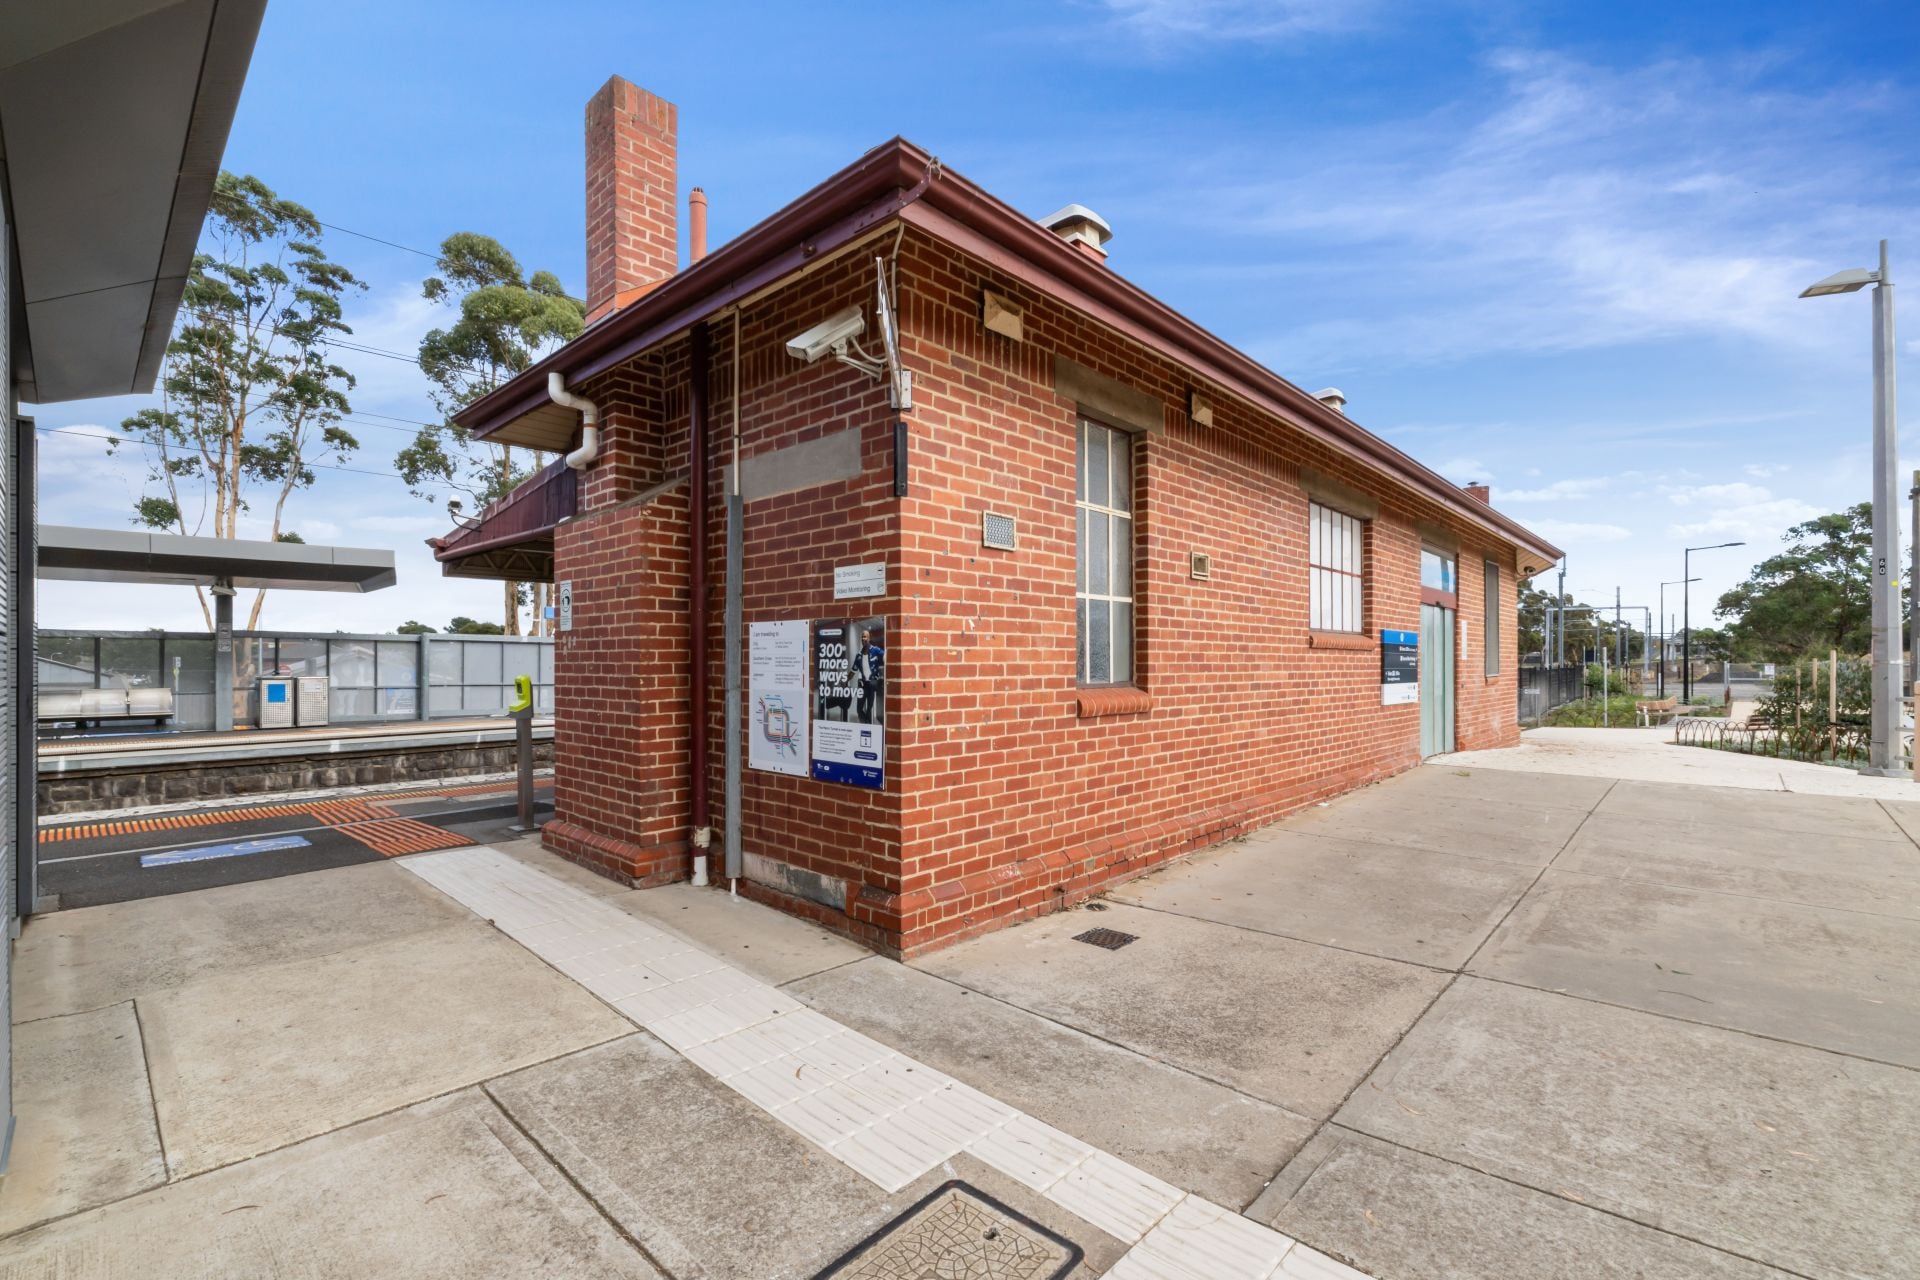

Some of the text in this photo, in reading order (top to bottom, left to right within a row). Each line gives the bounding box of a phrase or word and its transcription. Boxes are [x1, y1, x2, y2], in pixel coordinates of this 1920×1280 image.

[848, 586, 871, 594] Monitoring
[819, 658, 848, 669] more
[819, 670, 848, 685] ways
[819, 685, 864, 699] to move
